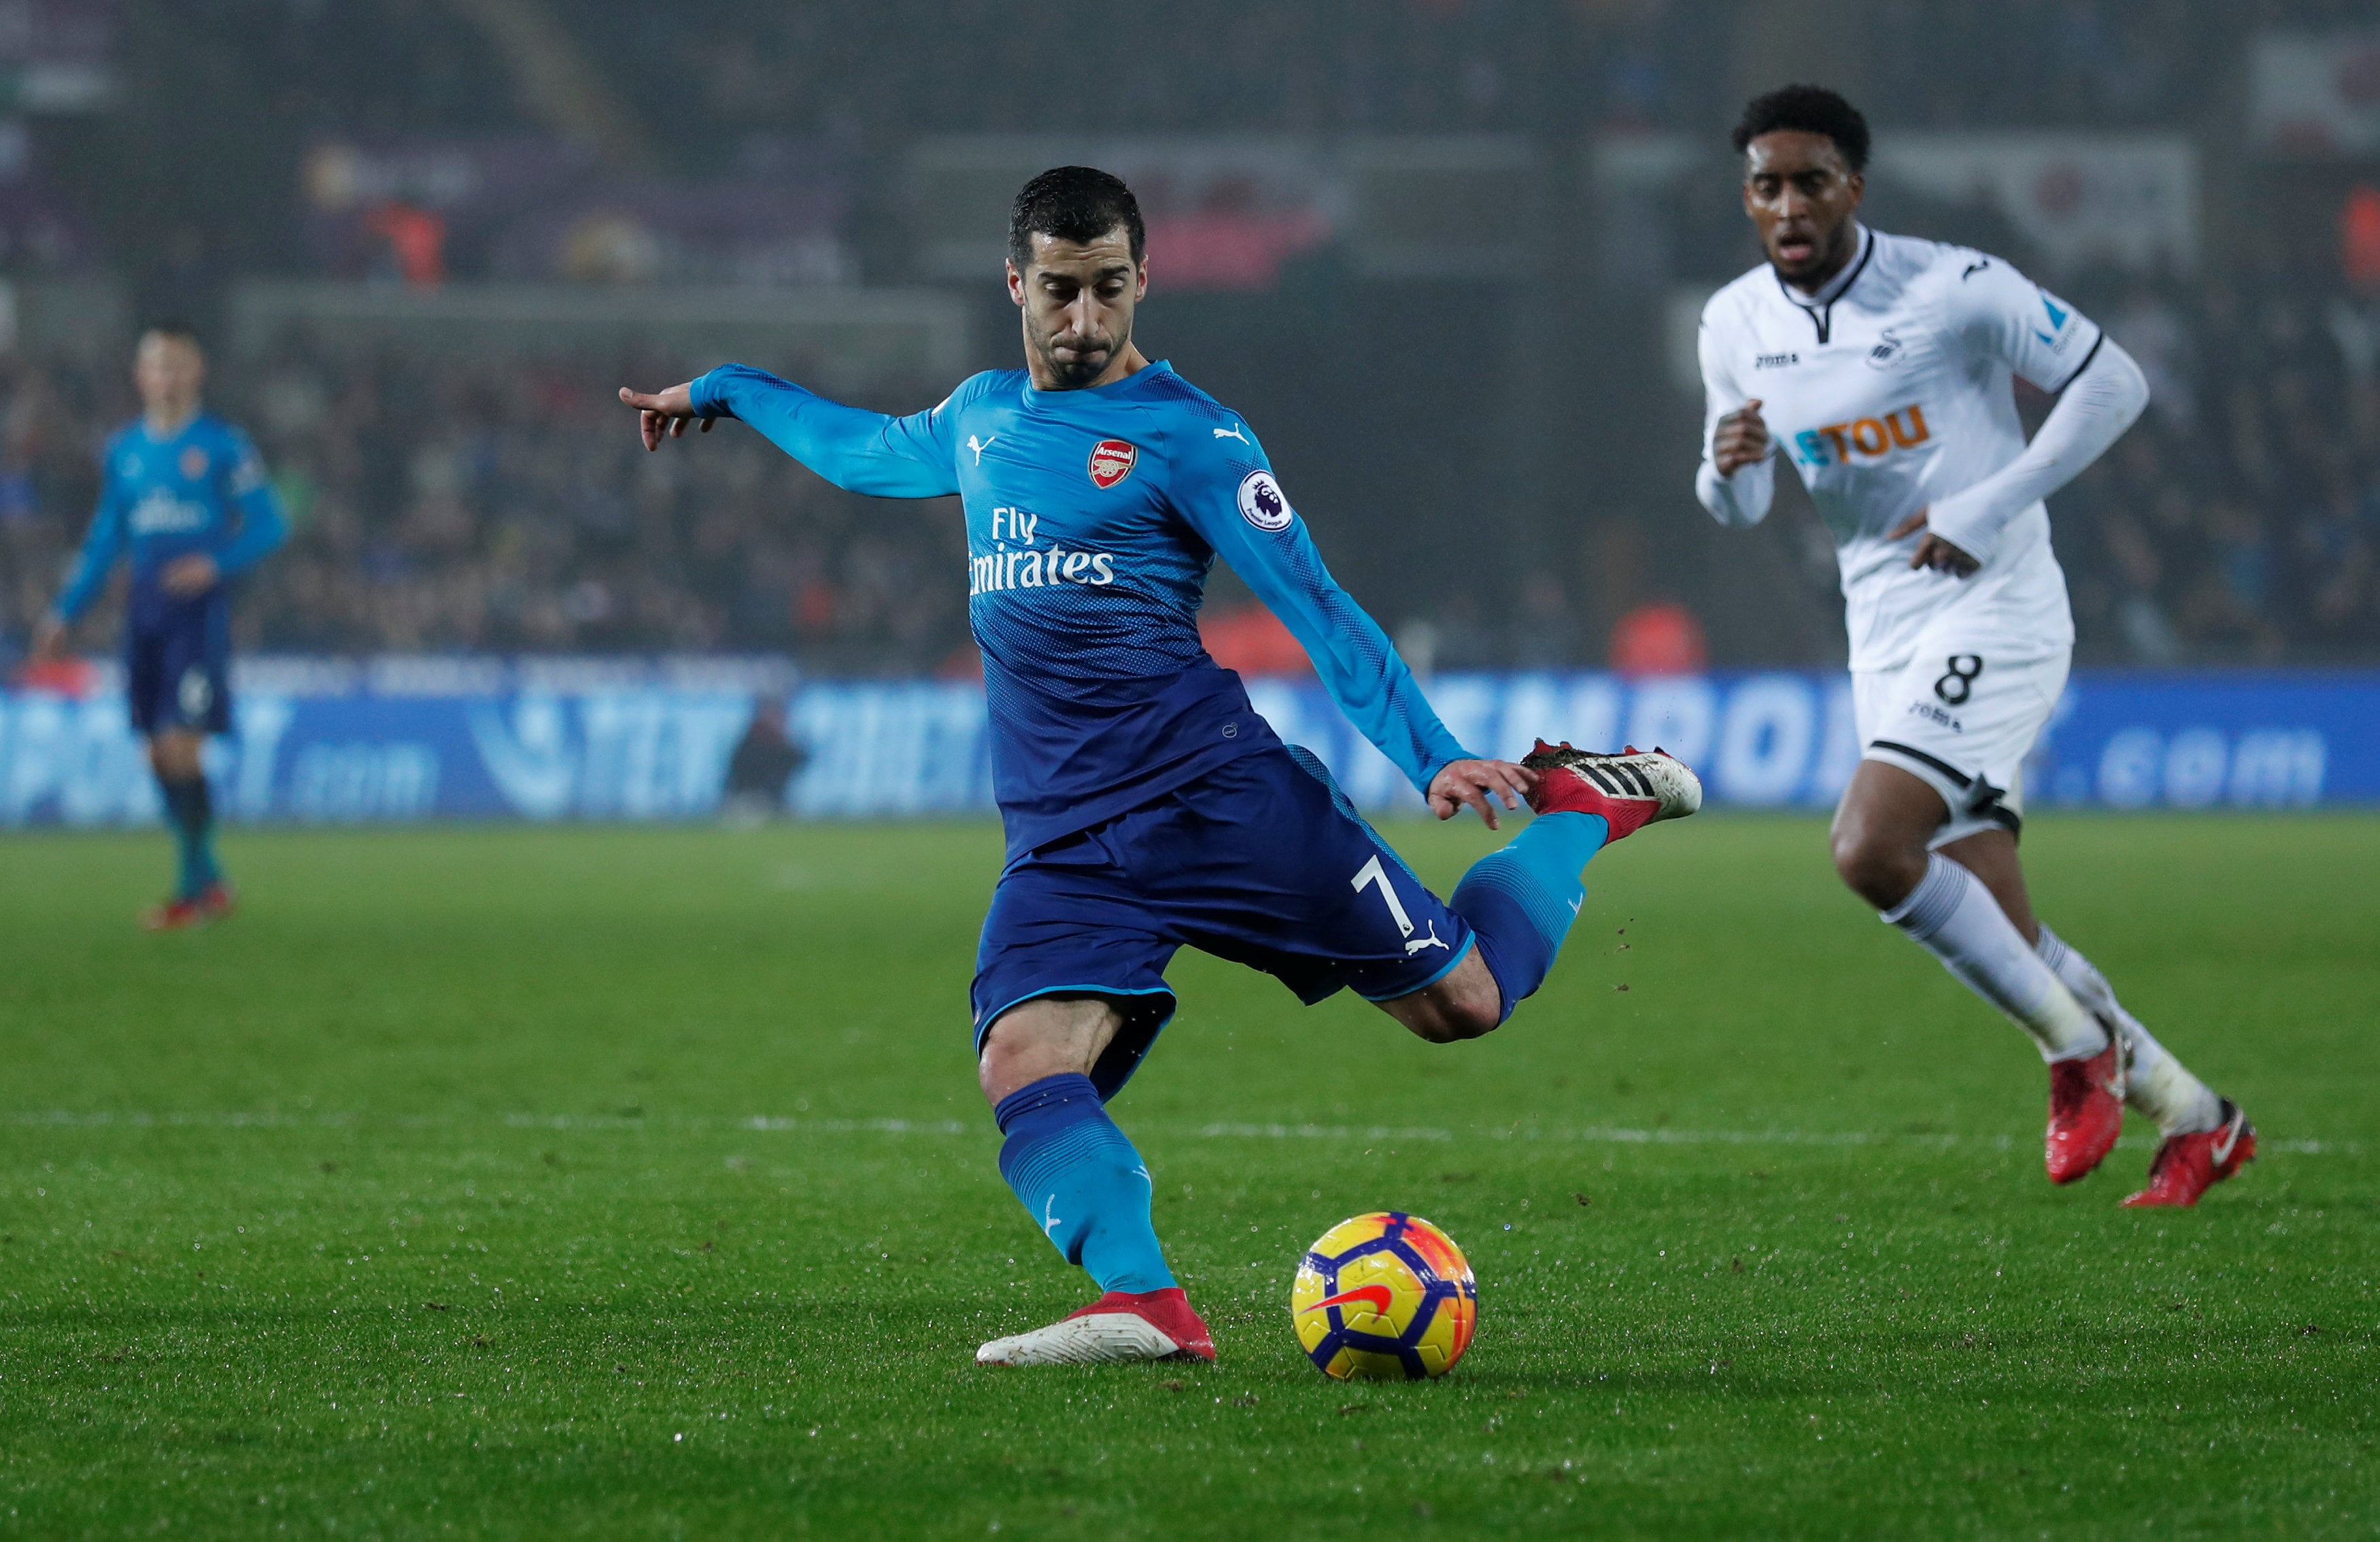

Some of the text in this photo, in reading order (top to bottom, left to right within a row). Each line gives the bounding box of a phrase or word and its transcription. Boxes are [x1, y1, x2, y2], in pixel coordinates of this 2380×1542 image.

[1097, 447, 1132, 460] Arsenal
[1778, 404, 1930, 466] ETOU
[992, 507, 1038, 545] Fly
[1935, 655, 1982, 704] 8
[1350, 854, 1415, 939] 7
